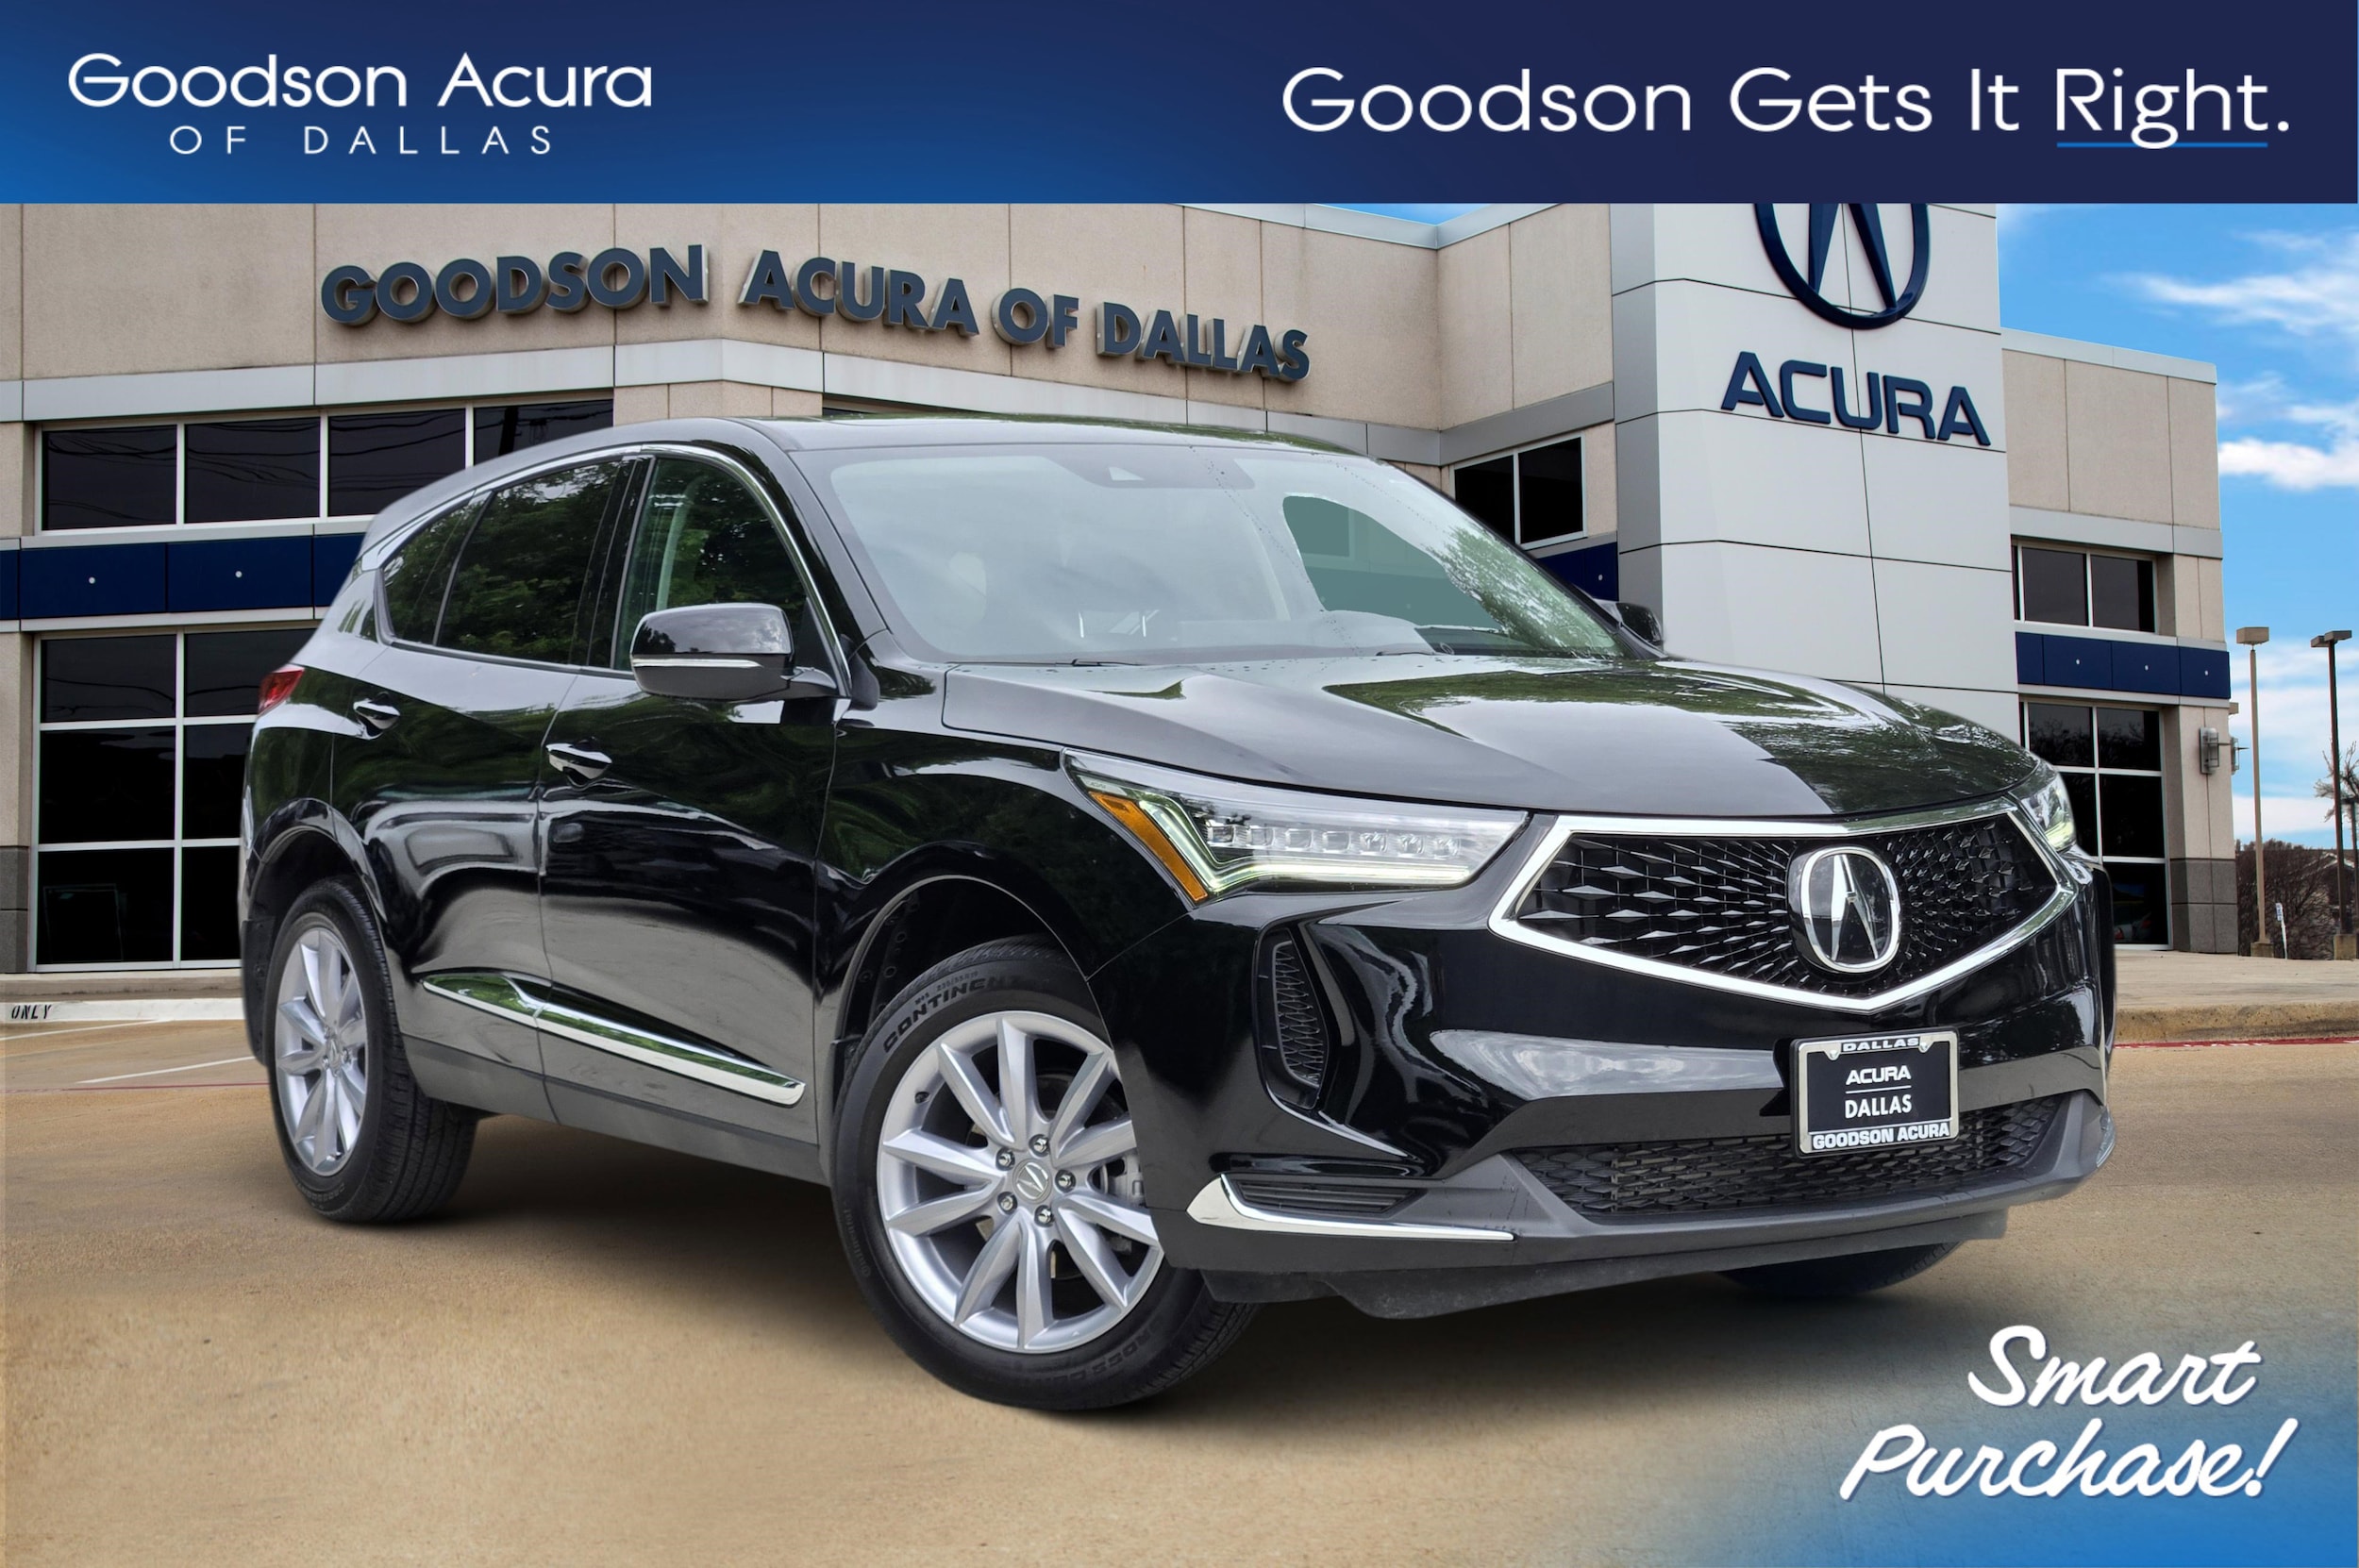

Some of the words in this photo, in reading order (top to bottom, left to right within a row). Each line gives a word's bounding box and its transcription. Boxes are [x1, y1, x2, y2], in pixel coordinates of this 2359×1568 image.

[321, 243, 708, 326] GOODSON
[738, 249, 979, 336] ACURA
[994, 287, 1079, 349] OF
[1096, 301, 1311, 381] DALLAS
[1721, 350, 1992, 447] ACURA
[11, 1004, 52, 1020] ONLY
[1842, 1037, 1919, 1052] DALLAS
[1845, 1064, 1912, 1085] ACURA
[1845, 1093, 1913, 1119] DALLAS
[1813, 1126, 1894, 1150] GOODSON
[1897, 1122, 1950, 1142] ACURA
